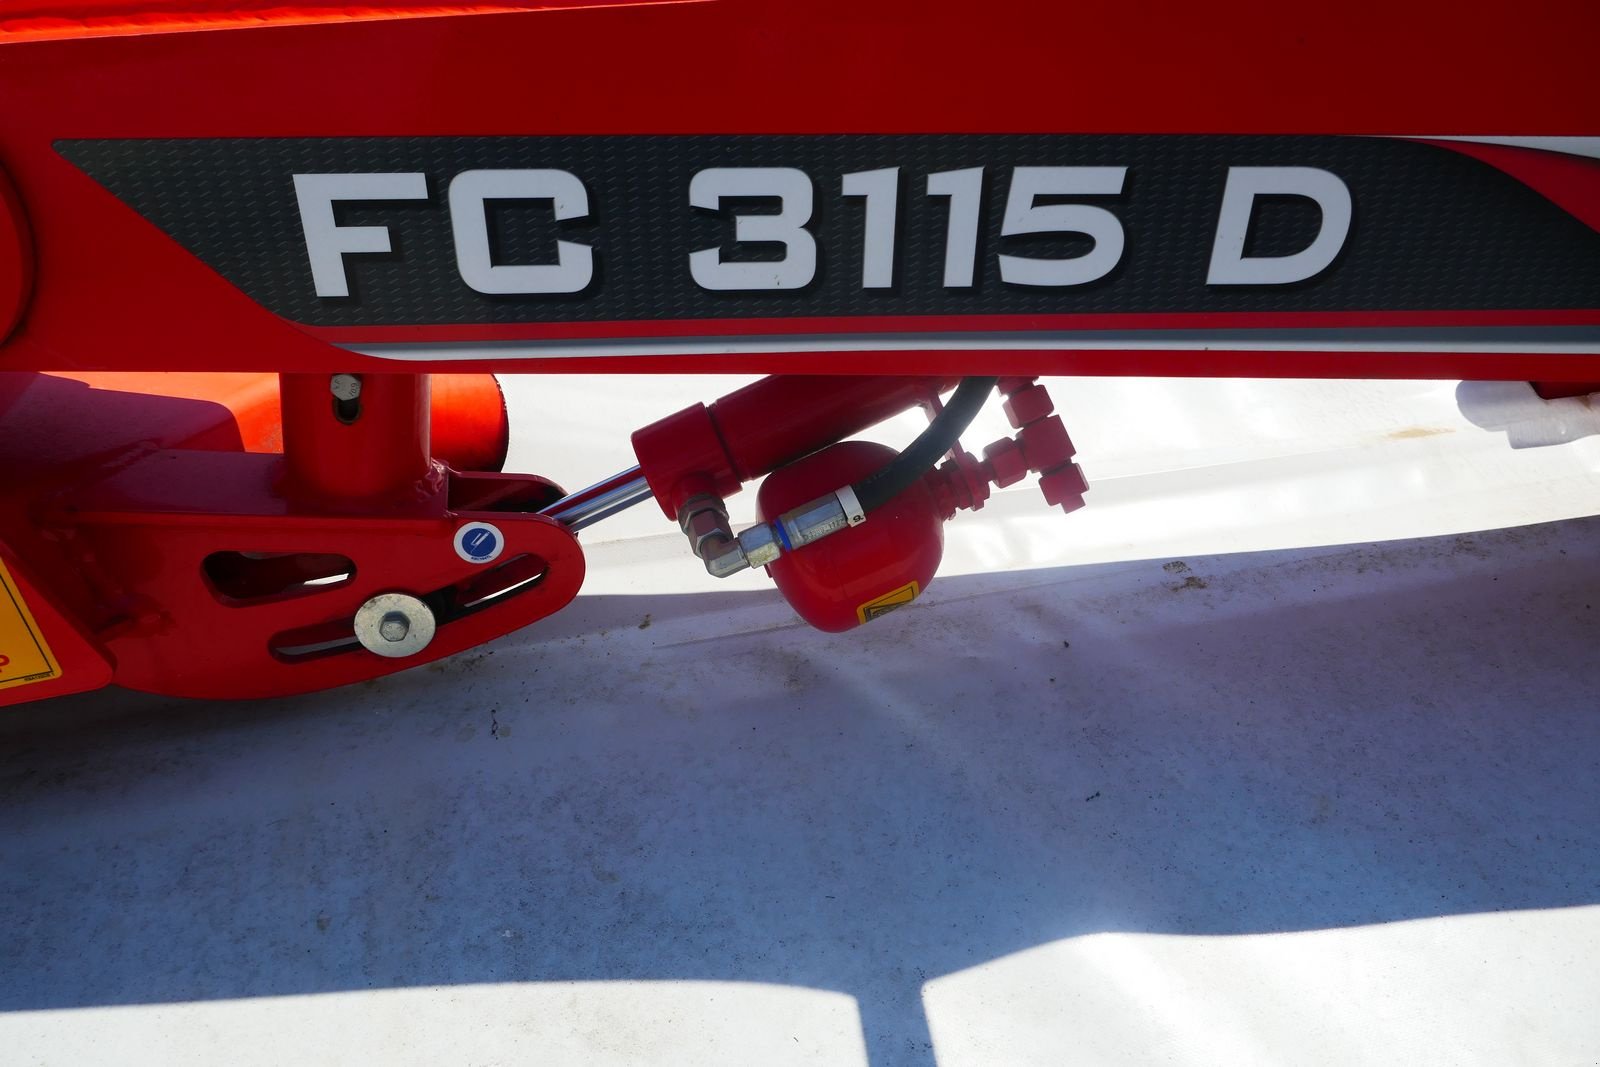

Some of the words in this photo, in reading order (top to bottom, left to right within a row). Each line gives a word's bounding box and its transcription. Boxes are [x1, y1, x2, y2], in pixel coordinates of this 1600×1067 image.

[293, 169, 593, 297] FC
[689, 166, 1127, 291] 3115
[1206, 166, 1352, 285] D
